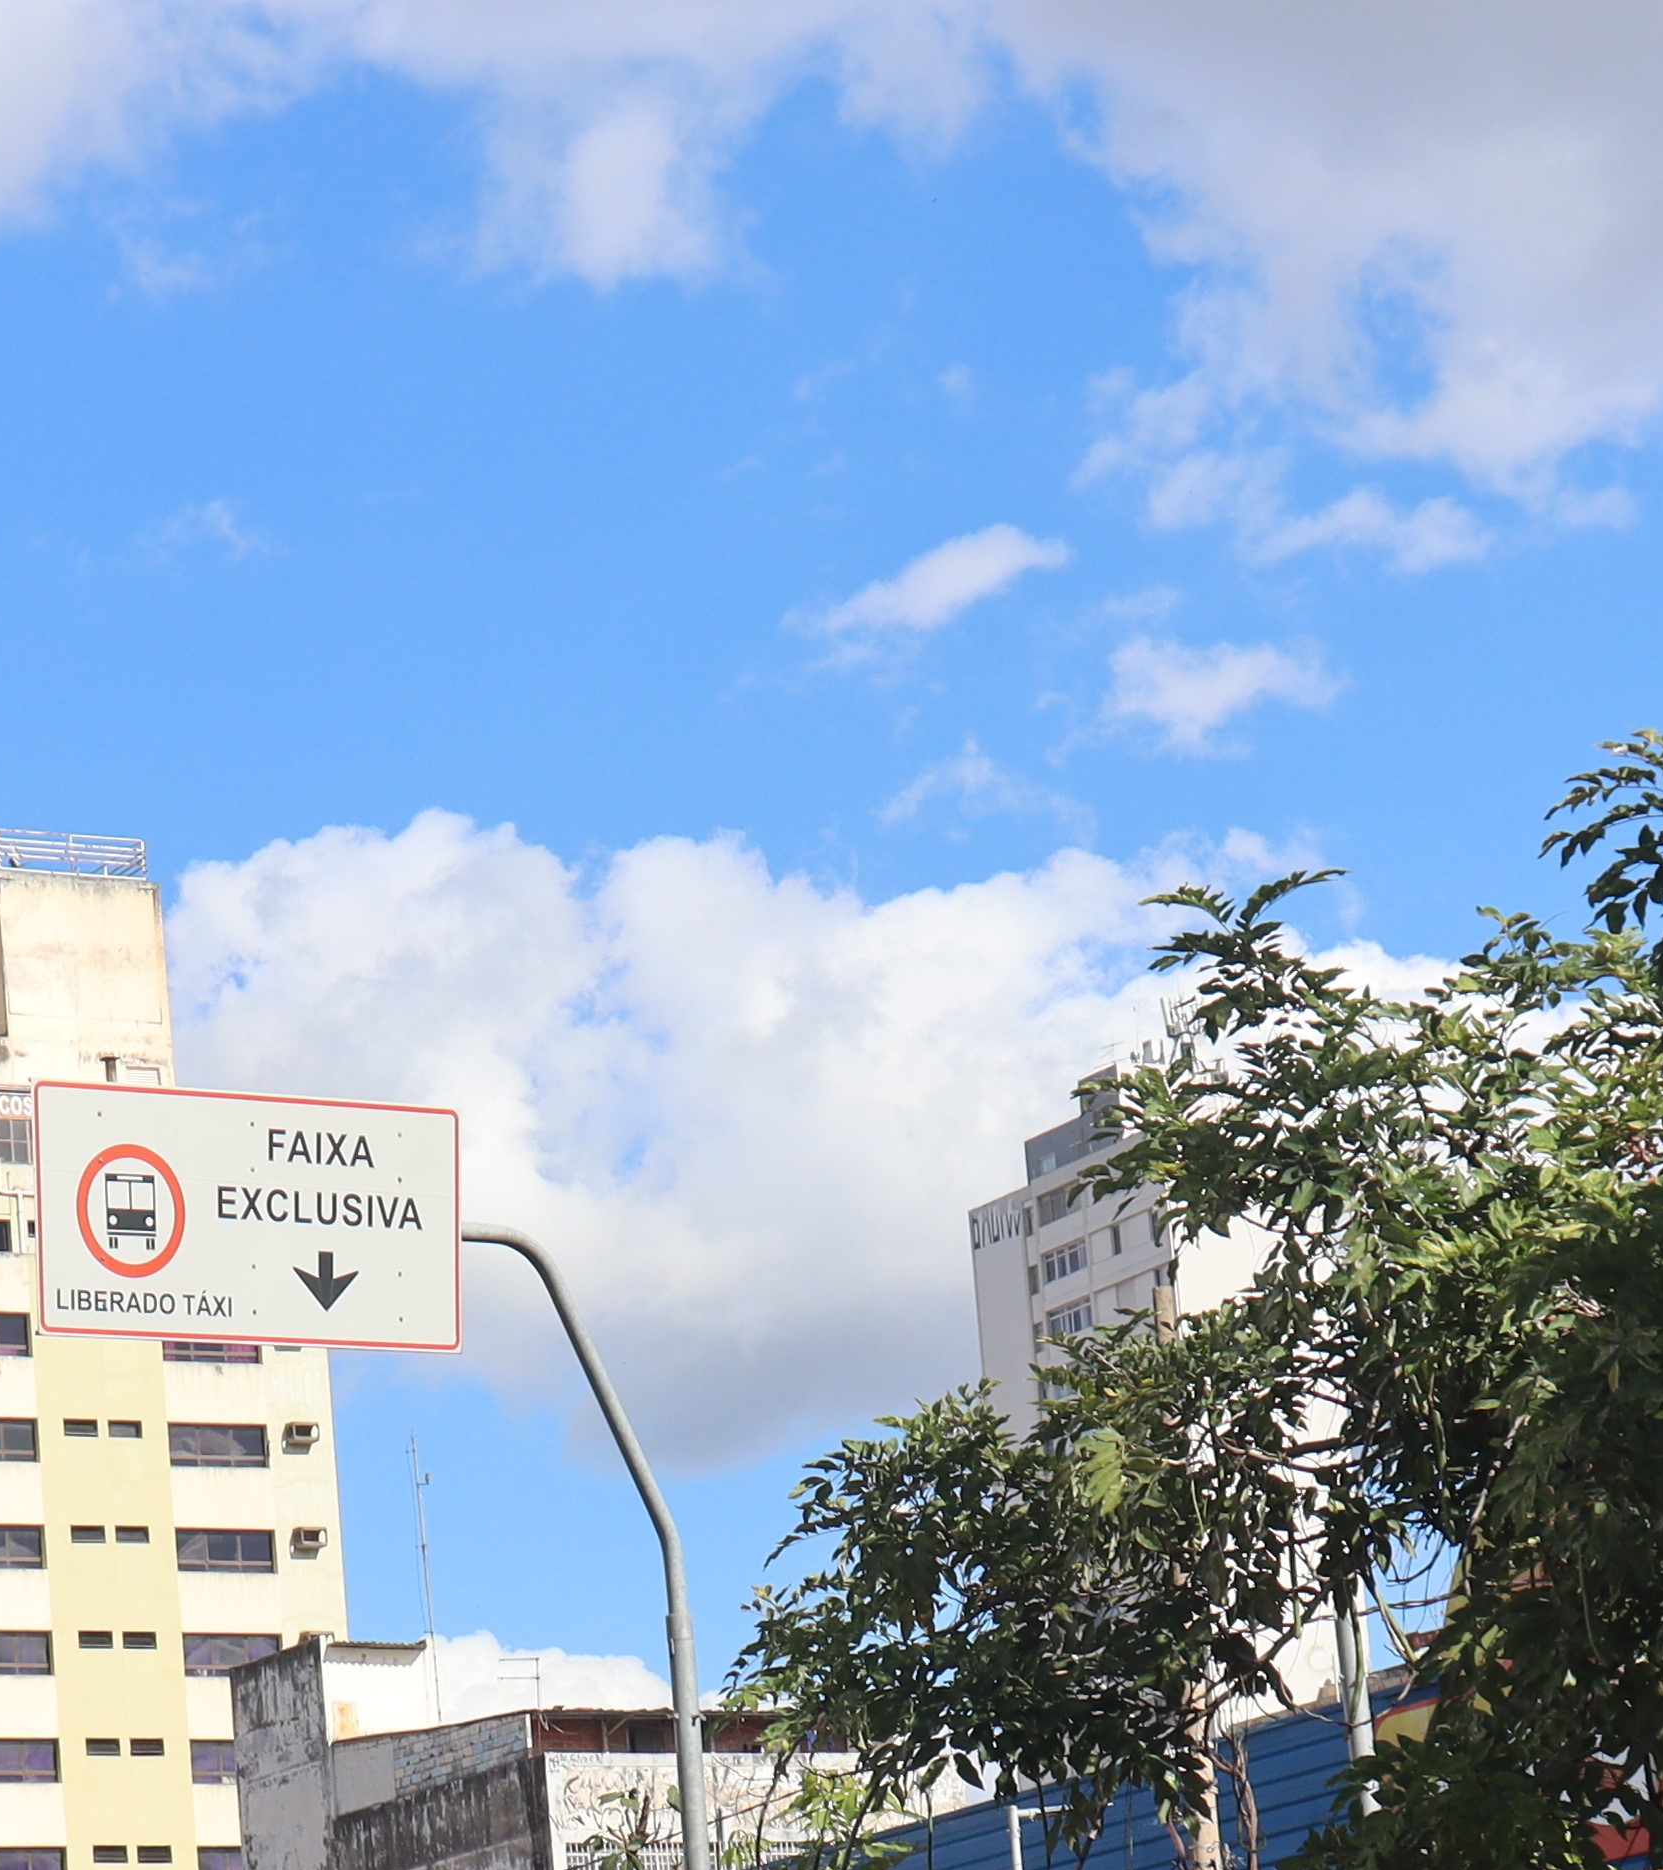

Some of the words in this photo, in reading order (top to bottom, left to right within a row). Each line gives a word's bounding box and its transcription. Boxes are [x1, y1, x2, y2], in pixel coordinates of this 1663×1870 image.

[267, 1128, 375, 1169] FAIXA
[217, 1185, 424, 1231] EXCLUSIVA
[55, 1287, 175, 1315] LIBERADO
[182, 1290, 233, 1318] TÁXI
